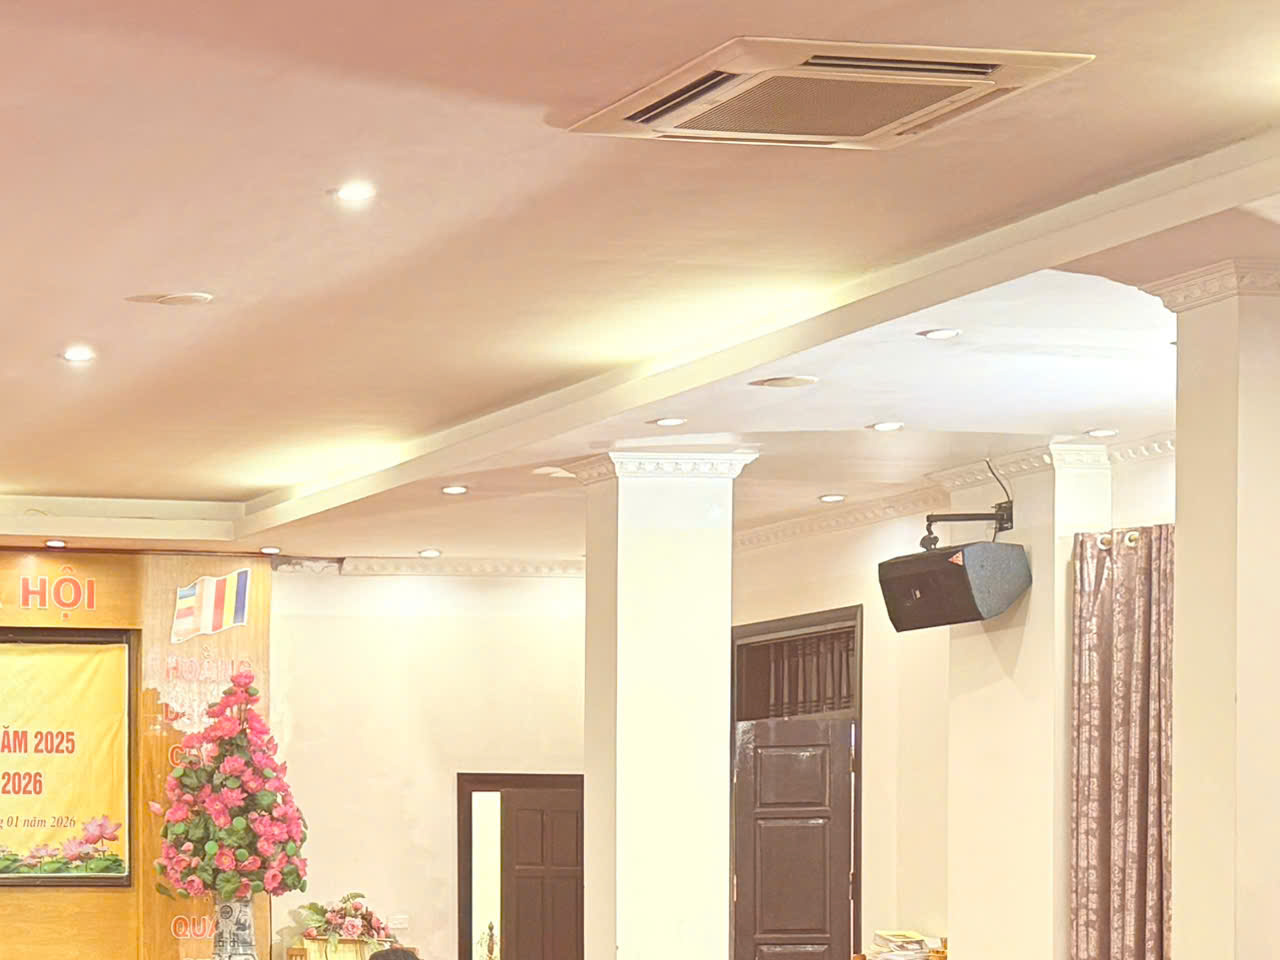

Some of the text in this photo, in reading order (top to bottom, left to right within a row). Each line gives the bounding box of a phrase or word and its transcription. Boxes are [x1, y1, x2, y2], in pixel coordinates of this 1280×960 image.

[20, 566, 96, 621] HỘI
[34, 731, 76, 754] 2025
[1, 772, 43, 795] 2026
[7, 815, 19, 828] 01
[23, 816, 46, 828] năm
[50, 816, 76, 828] 2026
